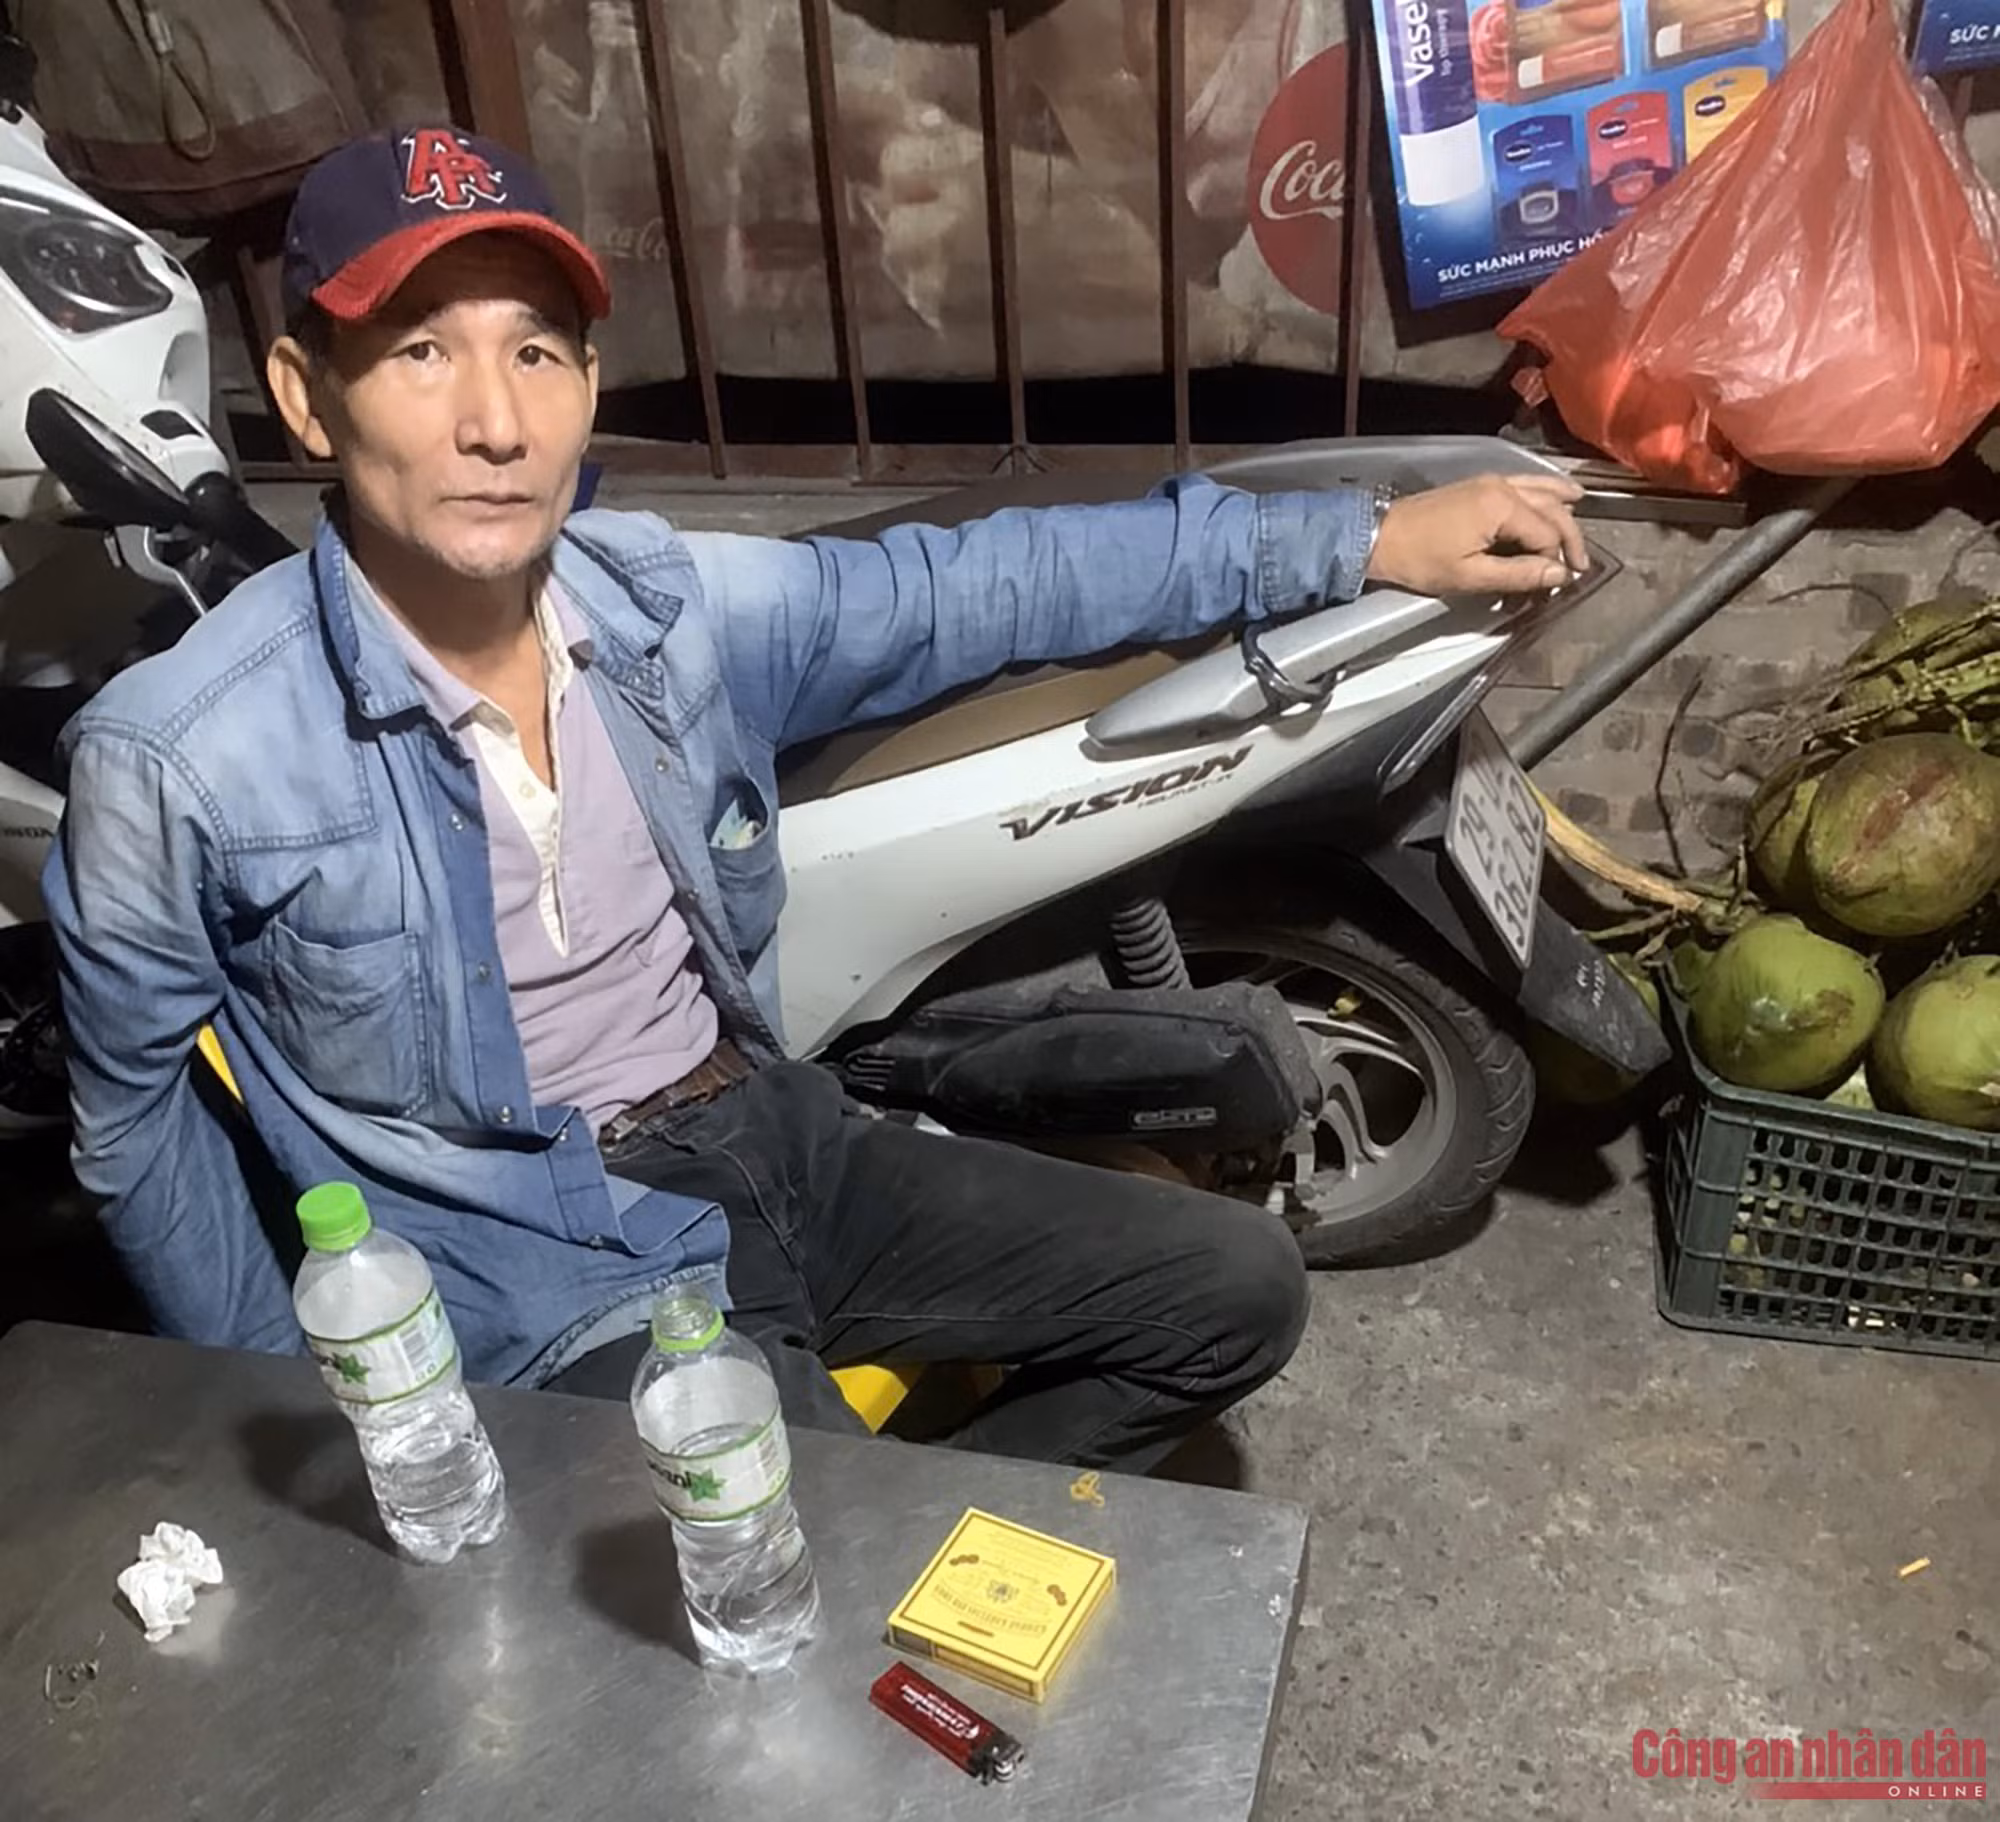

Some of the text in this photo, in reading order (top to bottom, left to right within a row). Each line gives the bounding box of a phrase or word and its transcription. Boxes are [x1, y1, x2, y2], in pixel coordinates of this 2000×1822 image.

[1404, 0, 1435, 88] Vase
[1437, 261, 1472, 283] SỨC
[1475, 252, 1525, 274] MẠNH
[1528, 240, 1574, 262] PHỤC
[1000, 744, 1254, 841] VISION
